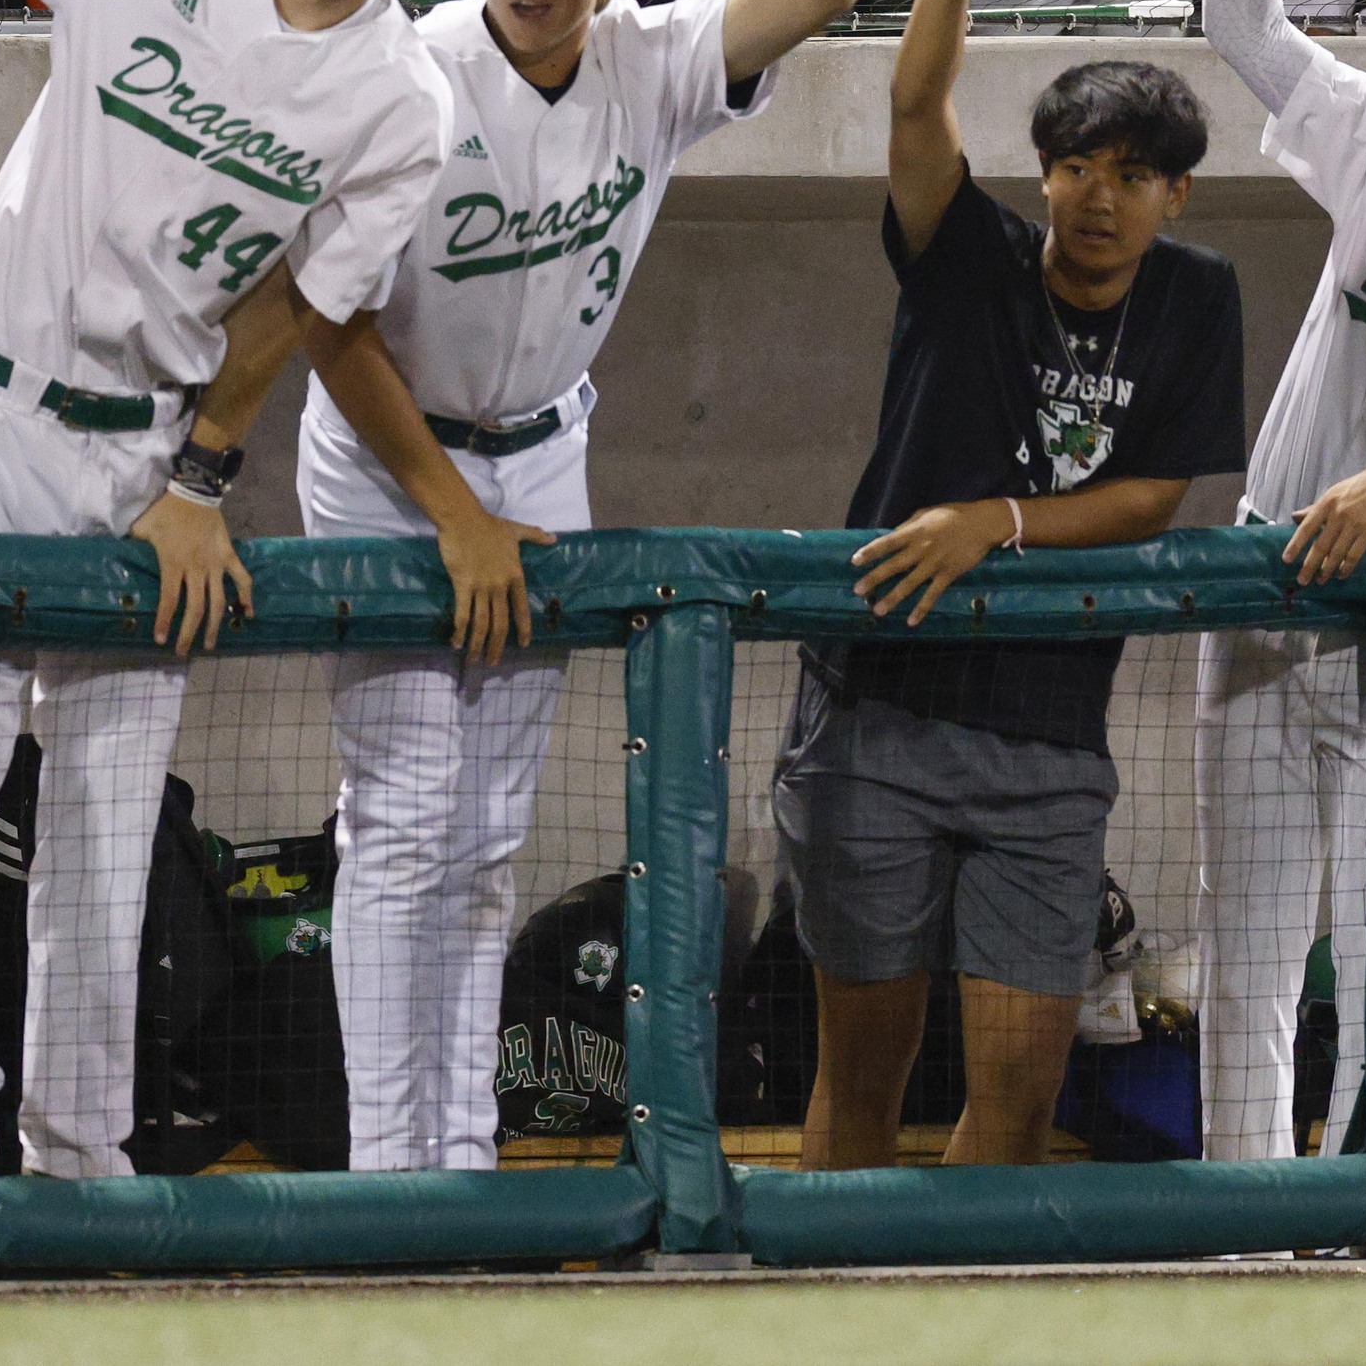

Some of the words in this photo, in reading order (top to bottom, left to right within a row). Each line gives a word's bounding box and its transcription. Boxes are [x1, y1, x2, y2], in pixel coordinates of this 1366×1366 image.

[101, 36, 322, 202] Dragons
[177, 203, 283, 293] 44
[580, 246, 622, 326] 3
